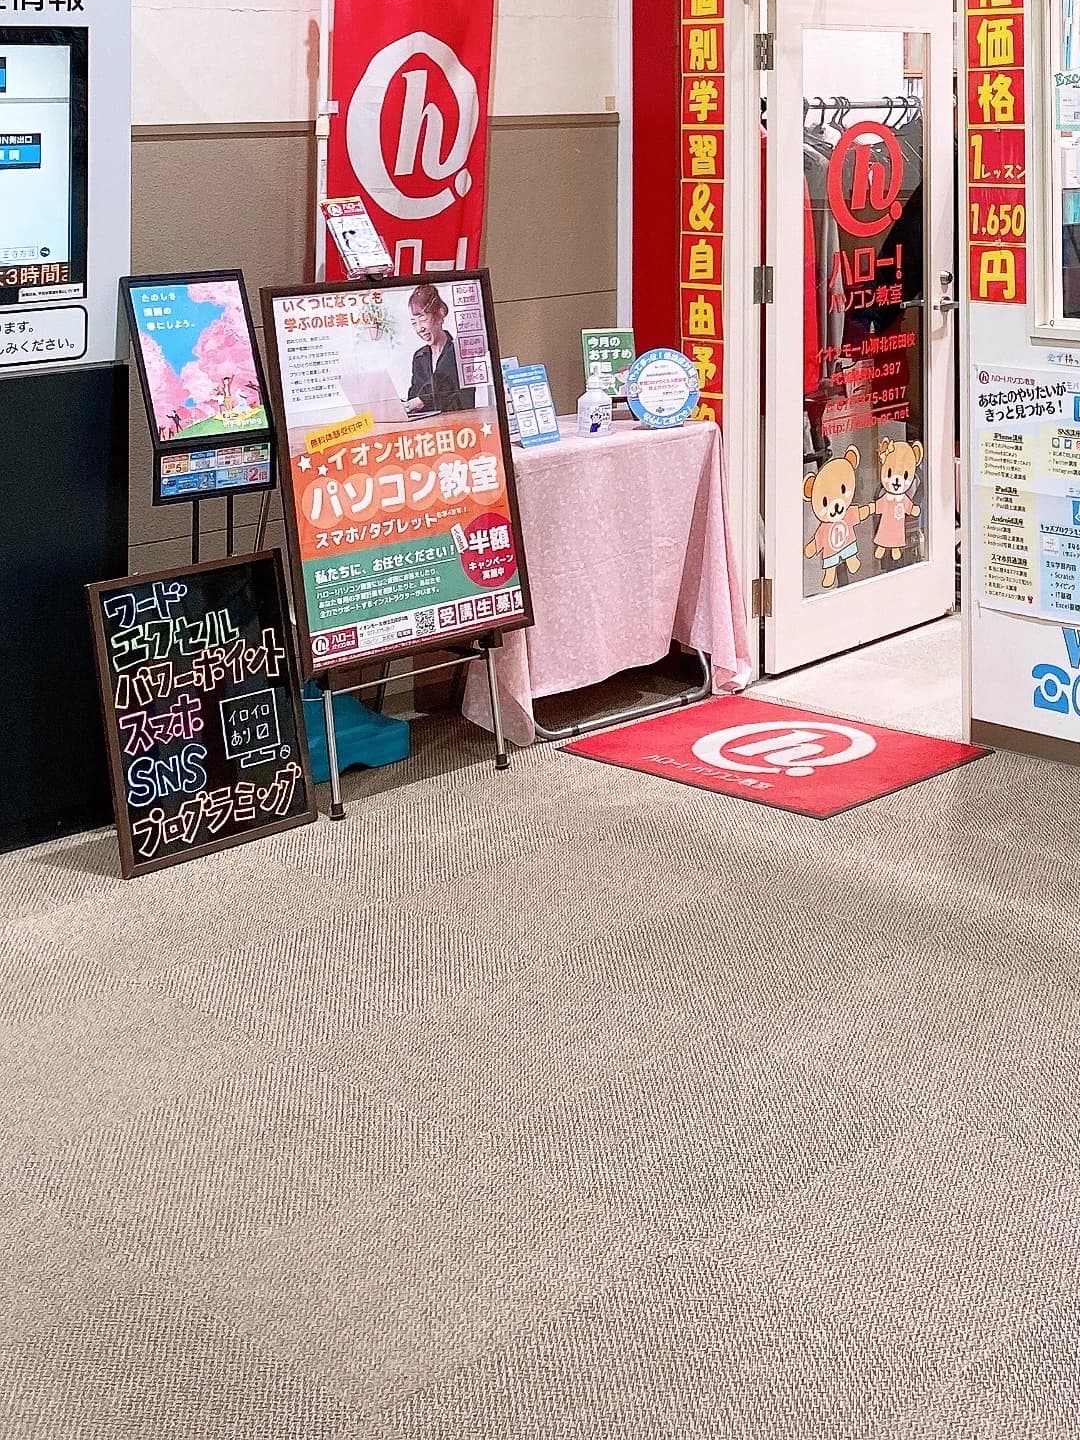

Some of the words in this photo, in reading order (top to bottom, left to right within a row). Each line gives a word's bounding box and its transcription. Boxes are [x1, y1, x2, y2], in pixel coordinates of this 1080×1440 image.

[829, 244, 903, 288] ハロー!
[979, 249, 1016, 299] 円
[282, 291, 383, 312] いくつになっても
[0, 321, 33, 334] ます。
[588, 336, 620, 348] 今月の
[589, 349, 632, 361] おすすめ
[978, 381, 1066, 408] あなたのやりたいが
[985, 400, 1063, 422] きっと見つかる!
[328, 427, 477, 471] イオン北花田の
[310, 455, 499, 520] パソコン教室
[315, 511, 437, 549] スマホ/タブレット
[469, 525, 510, 555] 半額
[468, 554, 514, 572] キャンペーン
[104, 582, 187, 628] ワード
[111, 609, 240, 673] エクセル
[115, 628, 285, 709] パワーポイント
[119, 693, 205, 756] スマホ
[127, 743, 208, 808] SNS
[133, 762, 302, 857] プログラミング
